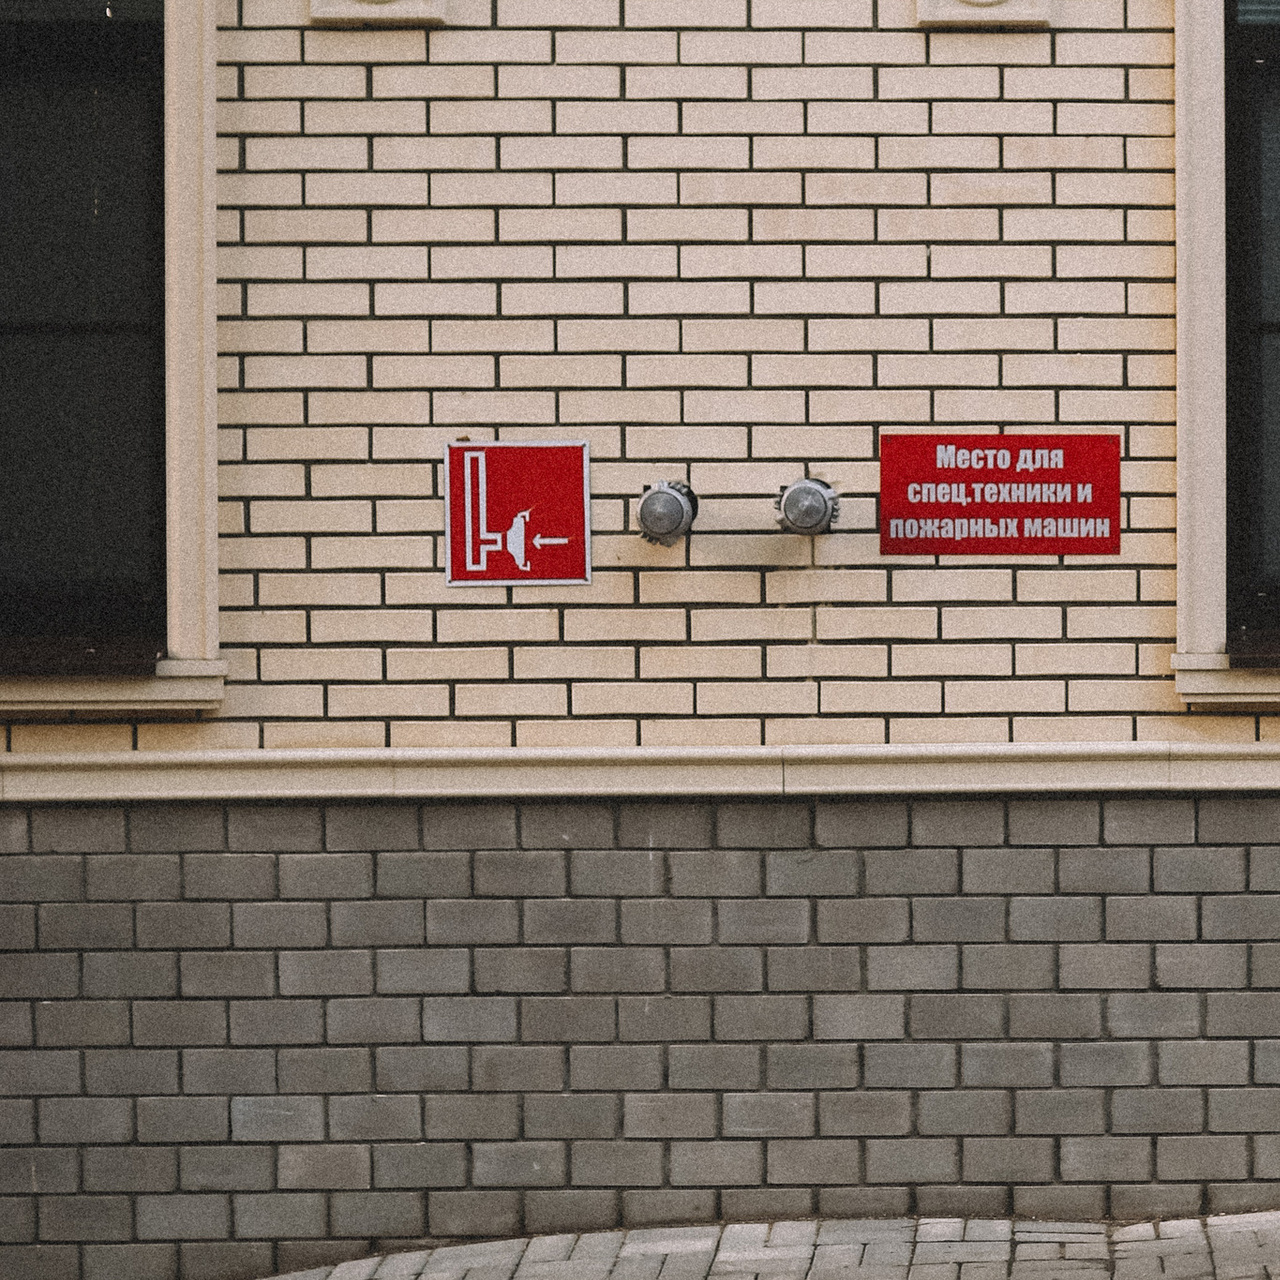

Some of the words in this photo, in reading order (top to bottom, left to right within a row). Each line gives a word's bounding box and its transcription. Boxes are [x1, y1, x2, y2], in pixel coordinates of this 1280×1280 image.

[936, 444, 1011, 469] Место
[1016, 448, 1064, 472] для
[907, 482, 1072, 506] спец.техники
[1076, 483, 1092, 503] и
[889, 517, 1019, 540] пожарных
[1023, 517, 1110, 538] машин
